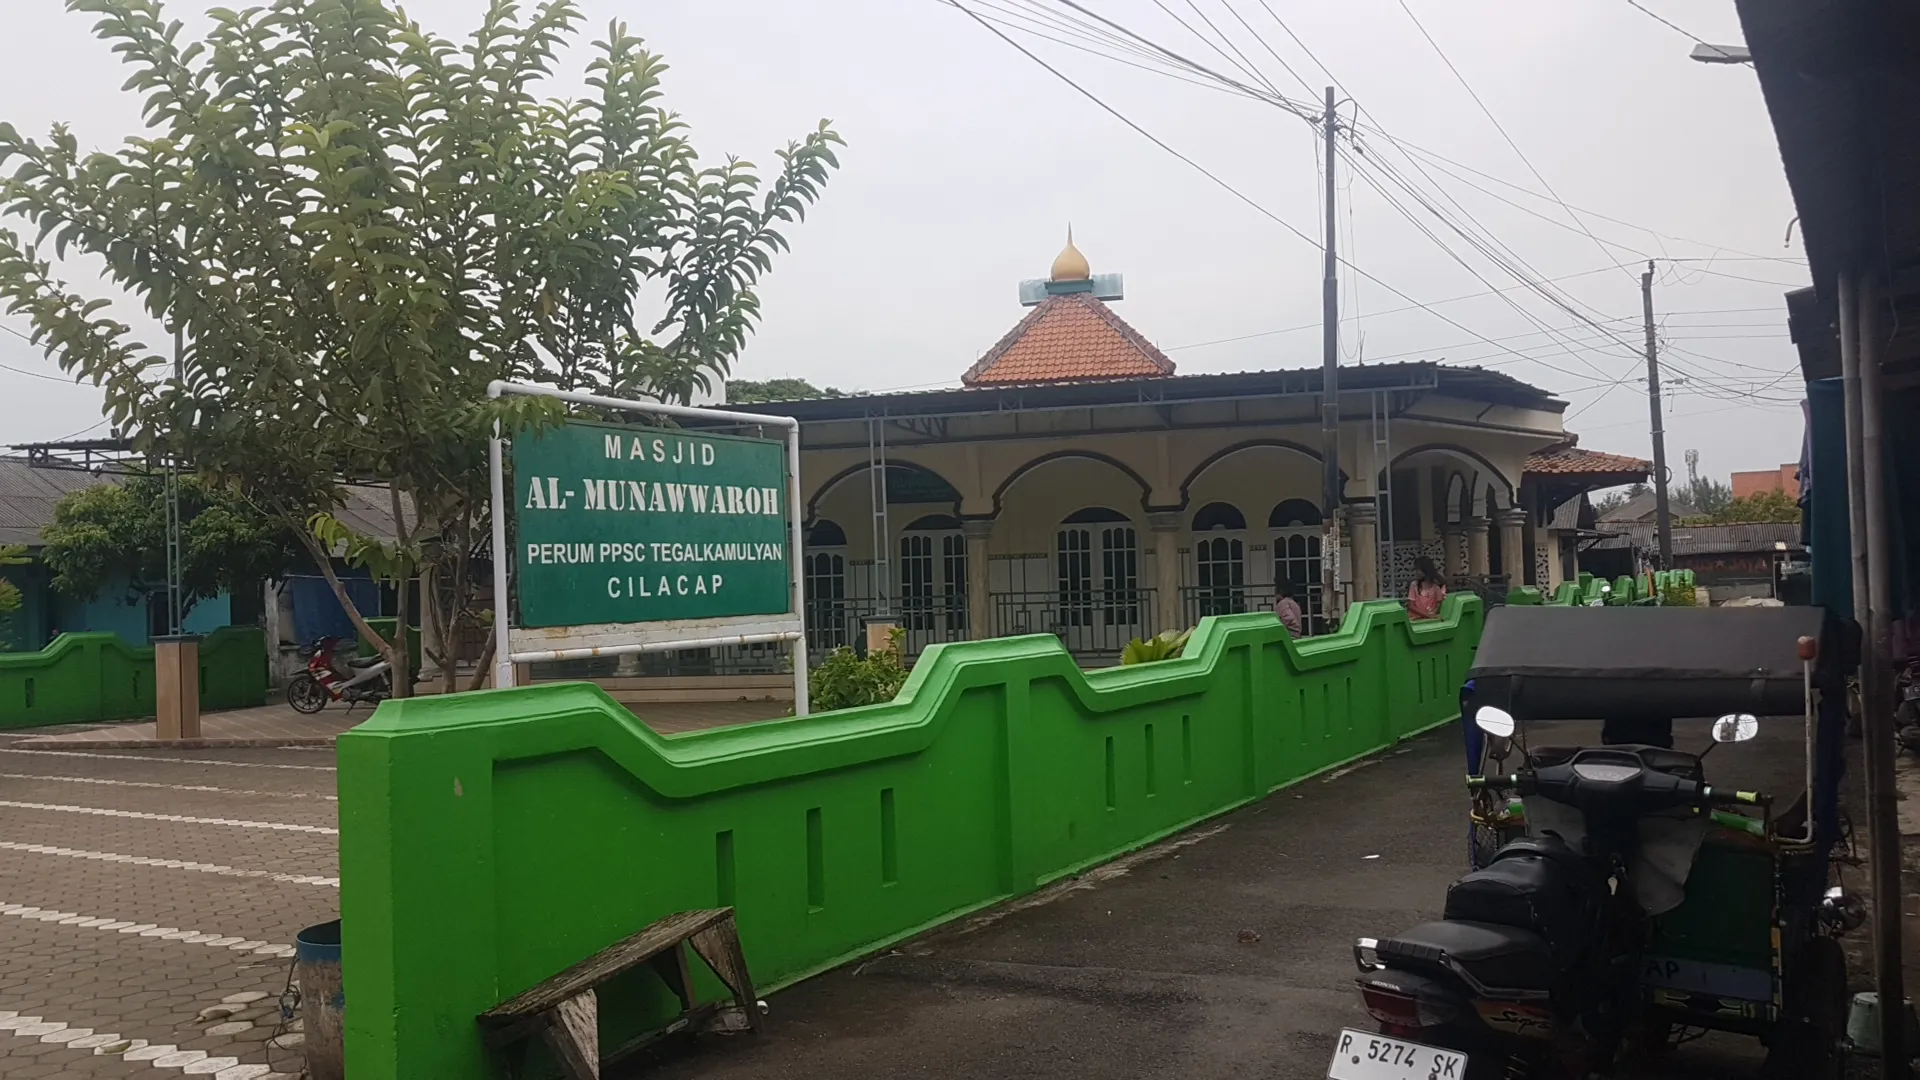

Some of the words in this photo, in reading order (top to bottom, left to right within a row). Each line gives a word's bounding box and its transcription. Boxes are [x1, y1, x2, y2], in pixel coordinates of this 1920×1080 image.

[604, 434, 715, 466] MASJID
[525, 476, 575, 509] AL-
[583, 478, 779, 515] MUNAWWAROH
[527, 543, 594, 564] PERUM
[600, 543, 646, 563] PPSC
[650, 543, 782, 562] TEGALKAMULYAN
[607, 574, 723, 598] CILACAP
[1340, 1034, 1353, 1054] R
[1368, 1040, 1416, 1068] 5274
[1431, 1054, 1459, 1078] SK
